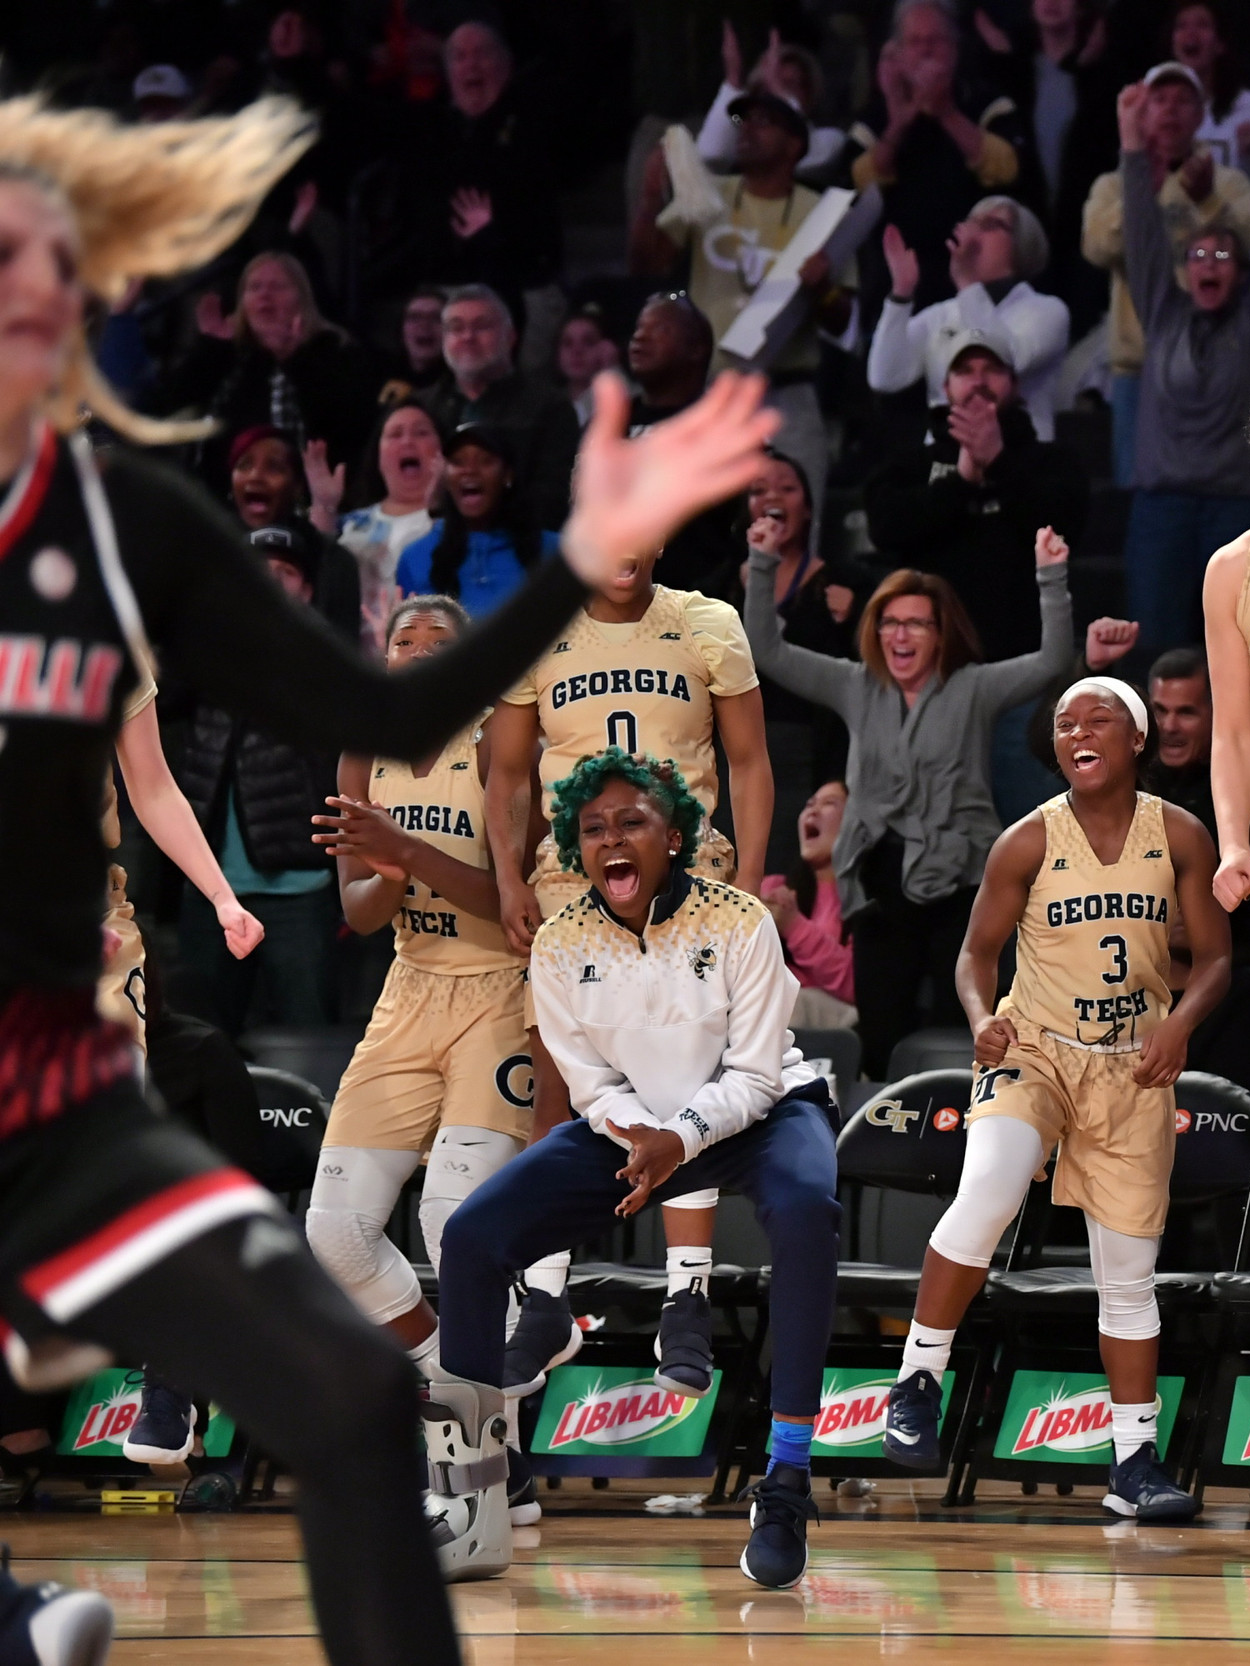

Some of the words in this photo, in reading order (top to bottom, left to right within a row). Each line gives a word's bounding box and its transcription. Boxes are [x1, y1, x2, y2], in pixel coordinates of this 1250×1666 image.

[551, 668, 691, 710] GEORGIA
[385, 805, 475, 838] ORGIA
[399, 907, 460, 938] TECH
[1047, 892, 1168, 927] GEORGIA
[1099, 934, 1129, 984] 3
[1074, 988, 1150, 1022] TECH
[259, 1107, 312, 1128] PNC
[865, 1099, 920, 1133] GT
[1195, 1113, 1249, 1132] PNC
[73, 1402, 141, 1450] LIB
[548, 1390, 687, 1449] LIBMAN
[1011, 1401, 1114, 1455] LIBM
